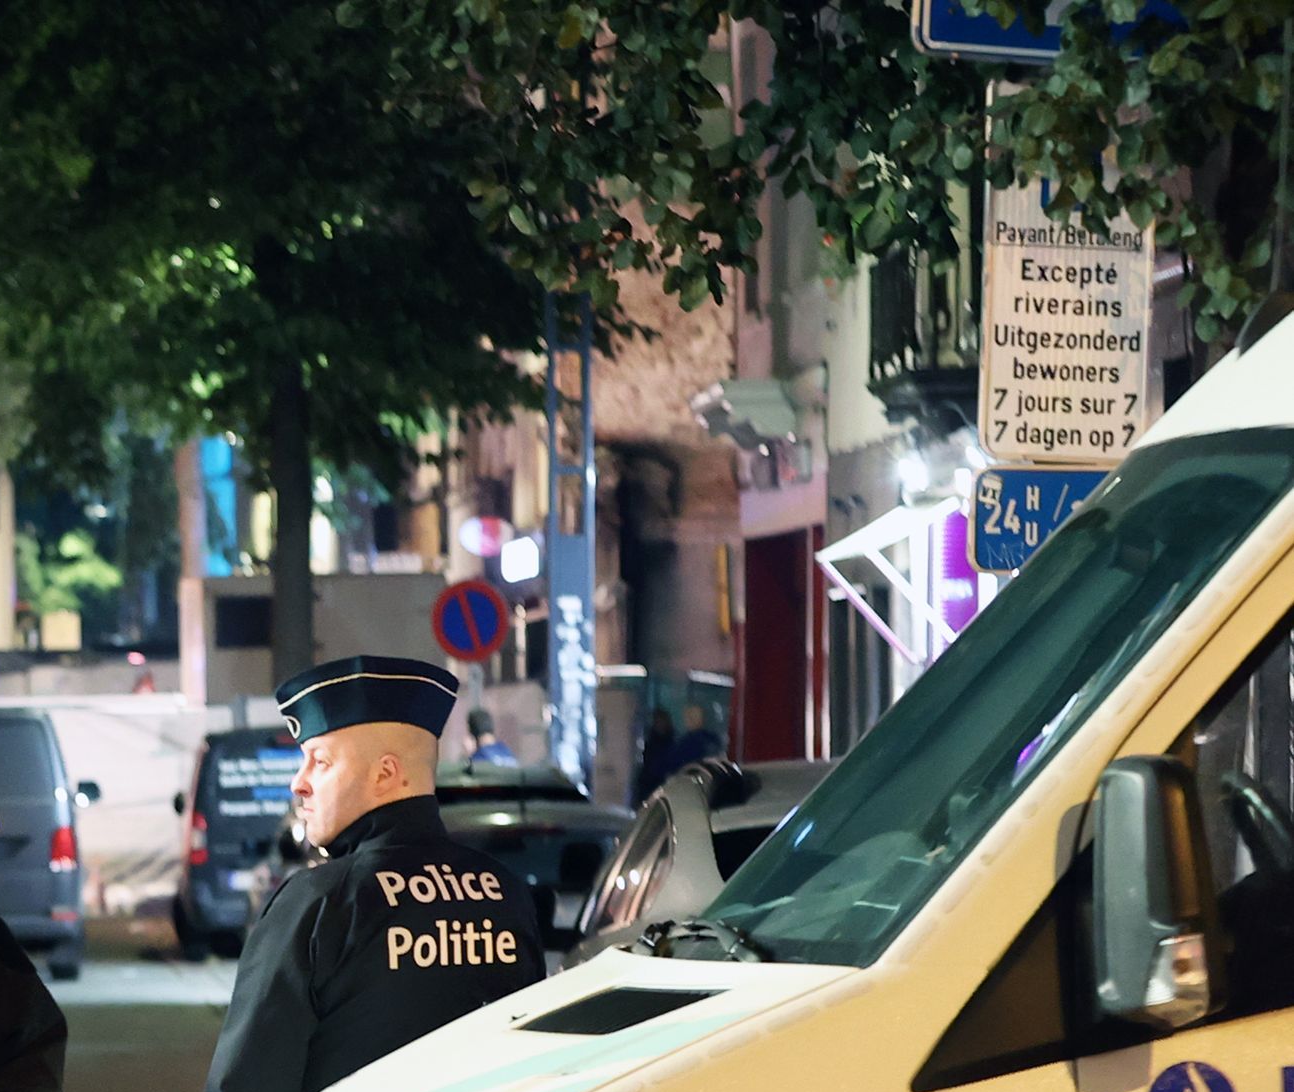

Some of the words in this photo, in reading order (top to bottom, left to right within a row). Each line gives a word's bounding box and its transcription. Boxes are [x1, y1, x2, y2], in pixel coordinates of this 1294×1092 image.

[1021, 258, 1118, 290] Excepté
[1013, 296, 1123, 318] riverains
[994, 323, 1141, 354] Uitgezonderd
[1012, 357, 1121, 384] bewoners
[994, 388, 1008, 411] 7
[1015, 390, 1073, 417] jours
[1080, 397, 1116, 415] sur
[1124, 393, 1138, 416] 7
[994, 420, 1009, 442] 7
[1015, 421, 1082, 451] dagen
[1089, 429, 1115, 452] op
[1122, 422, 1136, 448] 7
[984, 500, 1021, 535] 24
[376, 864, 504, 907] Police
[388, 920, 518, 970] Politie
